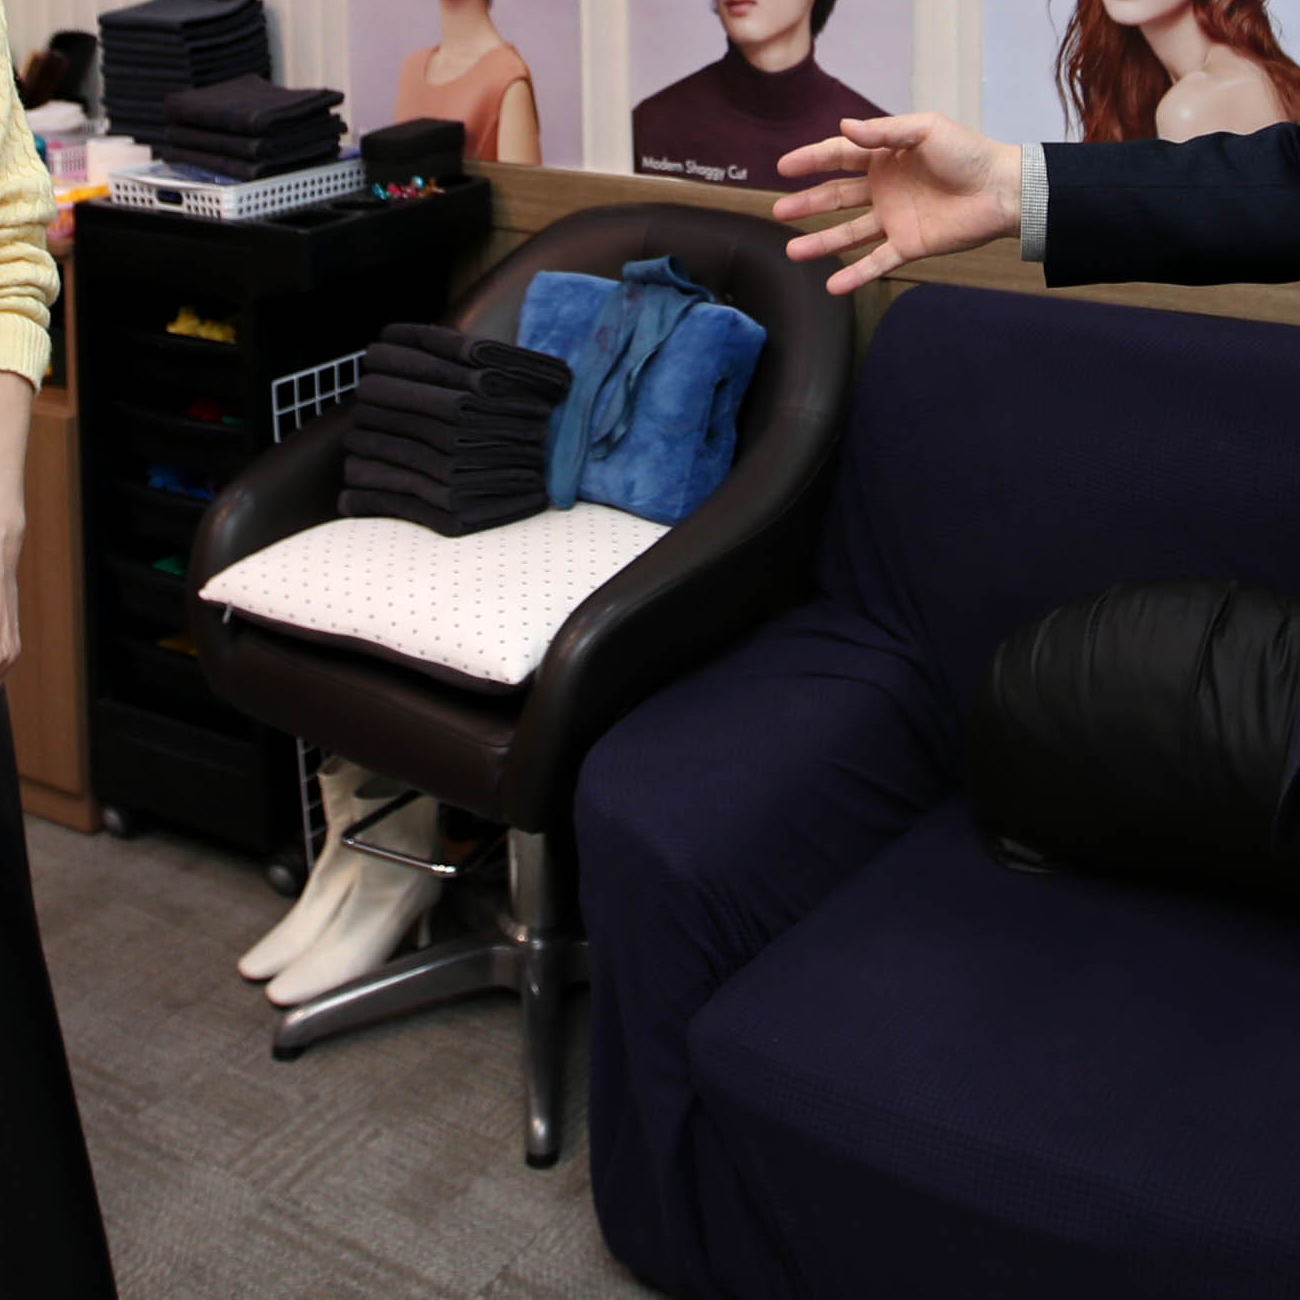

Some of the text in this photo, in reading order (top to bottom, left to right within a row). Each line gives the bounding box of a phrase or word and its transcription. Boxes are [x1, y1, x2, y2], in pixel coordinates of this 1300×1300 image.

[641, 156, 749, 182] Modern Shaggy Cut
